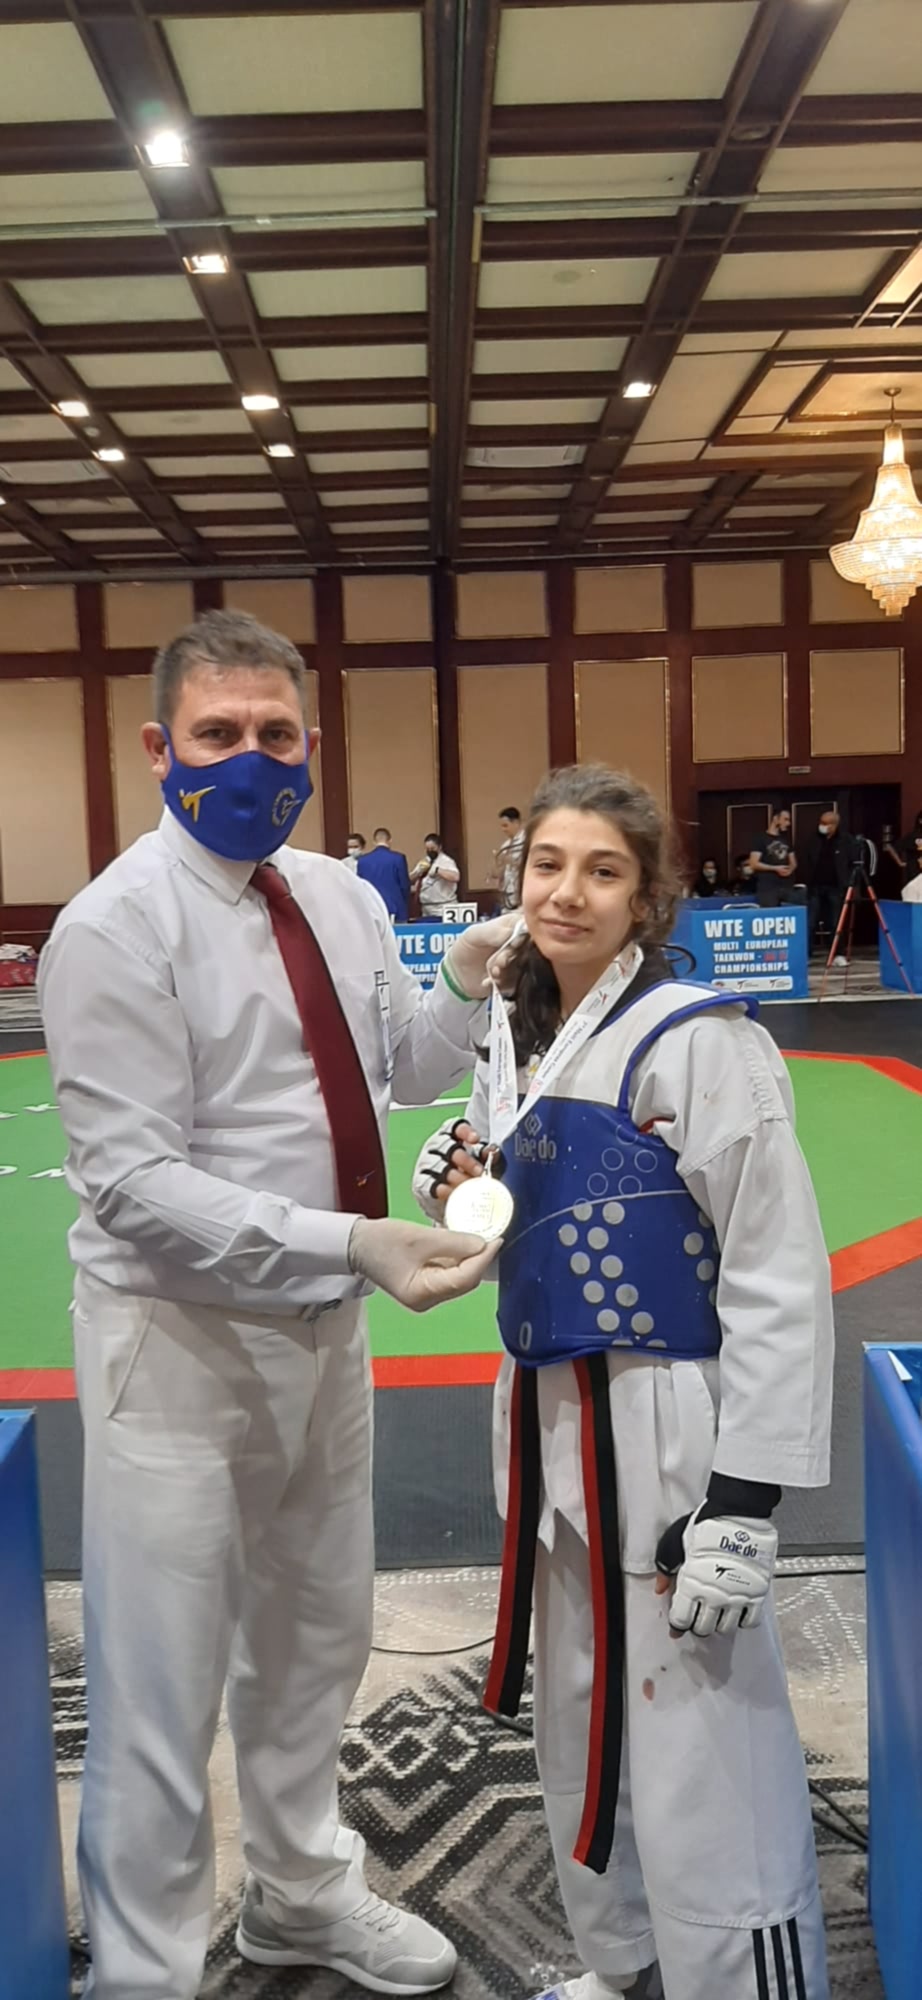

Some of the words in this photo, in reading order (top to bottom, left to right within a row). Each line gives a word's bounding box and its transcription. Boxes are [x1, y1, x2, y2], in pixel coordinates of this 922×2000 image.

[704, 919, 744, 939] WTE
[752, 916, 797, 936] OPEN
[430, 932, 465, 954] OP
[713, 941, 739, 951] MULTI
[745, 939, 789, 950] EUROPEAN
[713, 952, 755, 963] TAEKWON
[714, 962, 789, 974] CHAMPIONSHIPS
